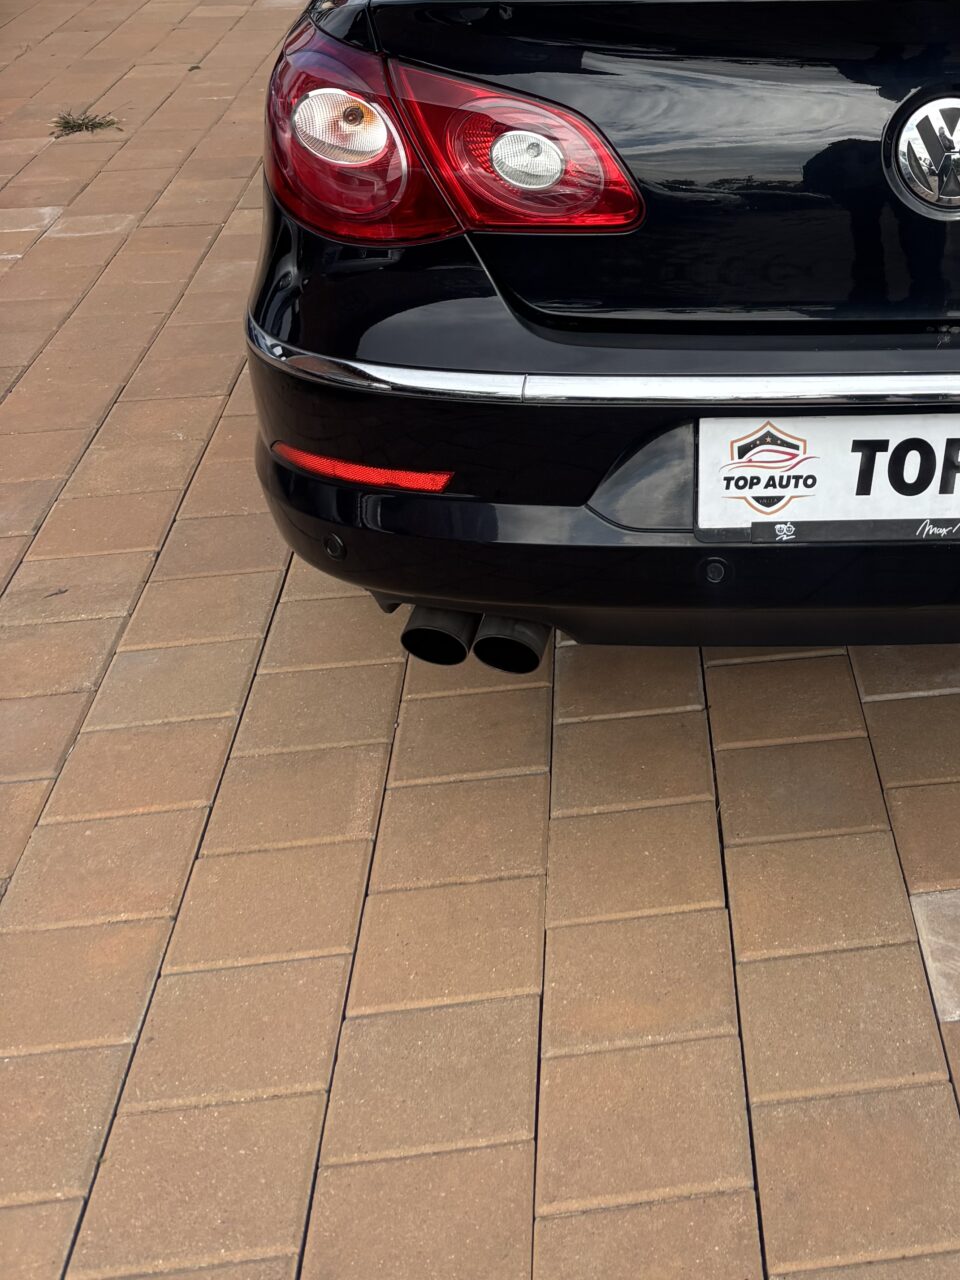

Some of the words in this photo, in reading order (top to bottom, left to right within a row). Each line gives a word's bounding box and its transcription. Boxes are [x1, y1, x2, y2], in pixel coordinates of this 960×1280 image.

[723, 475, 761, 491] TOP
[763, 474, 818, 489] AUTO
[916, 519, 953, 539] Max
